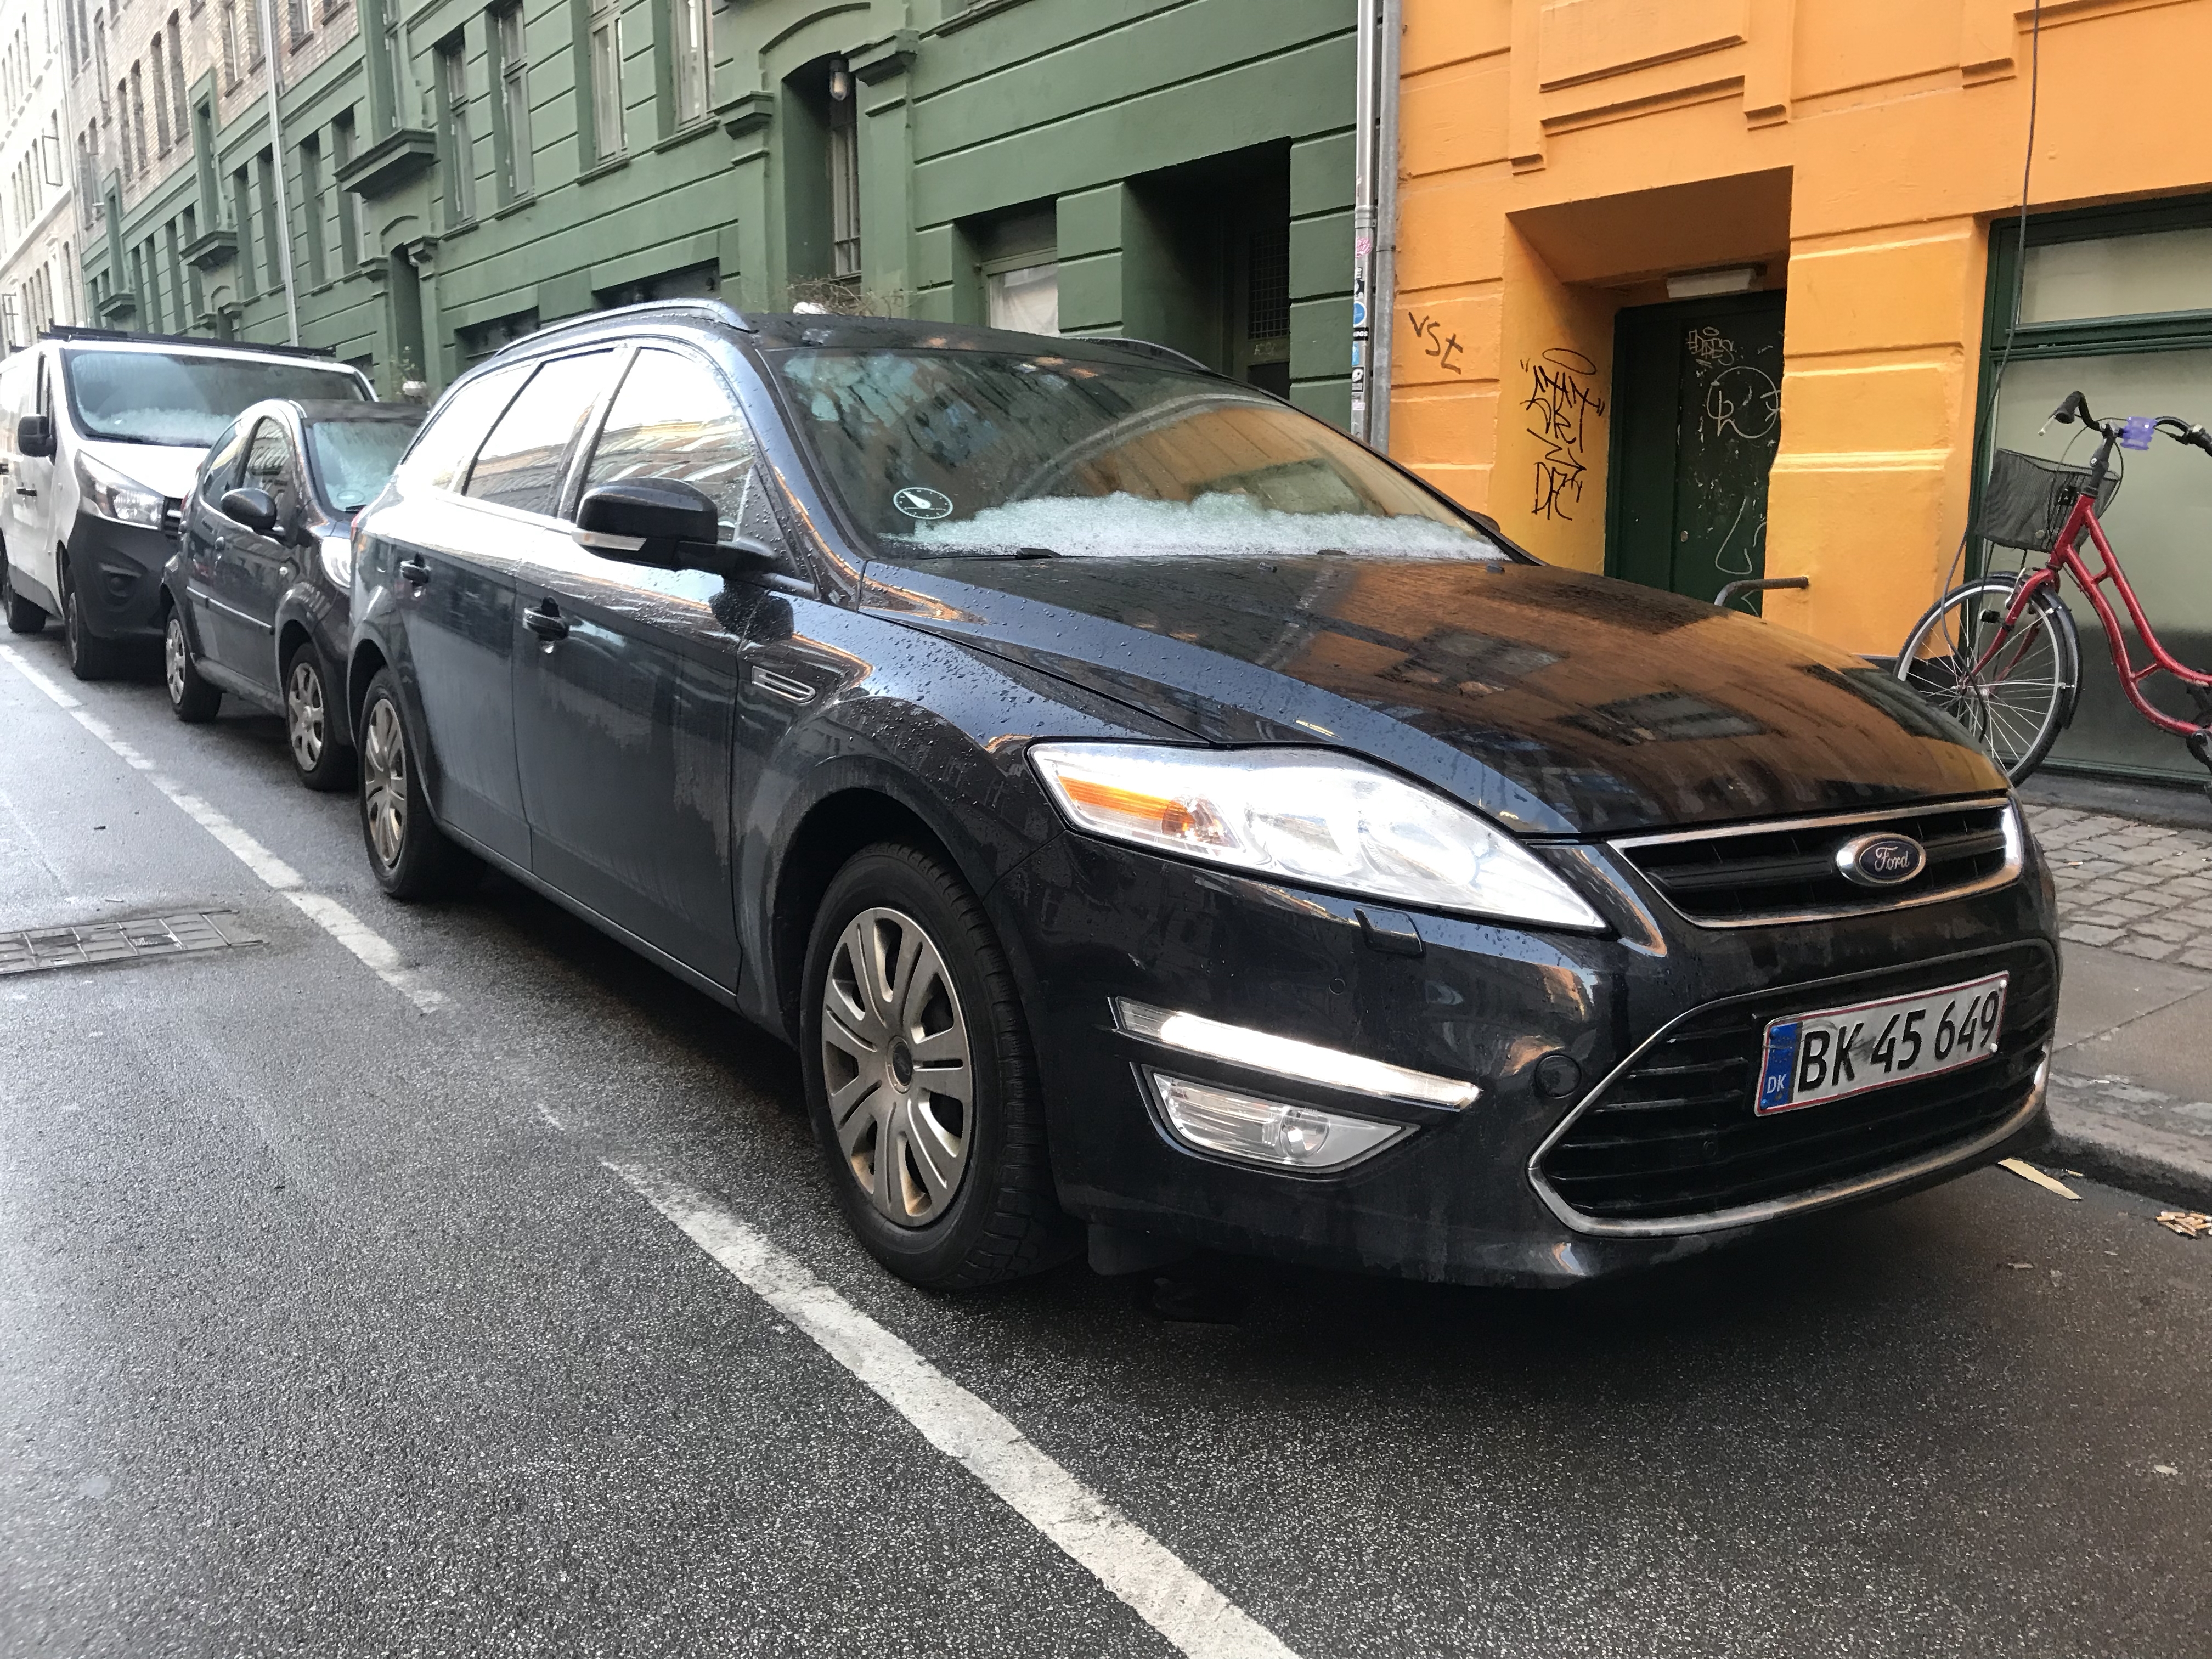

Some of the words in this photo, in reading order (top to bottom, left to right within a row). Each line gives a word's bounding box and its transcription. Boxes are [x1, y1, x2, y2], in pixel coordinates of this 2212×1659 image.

[1874, 846, 1910, 872] Ford
[1797, 1022, 1865, 1093] BK
[1870, 1008, 1926, 1074] 45
[1934, 990, 2000, 1061] 649
[1766, 1073, 1788, 1094] DK
